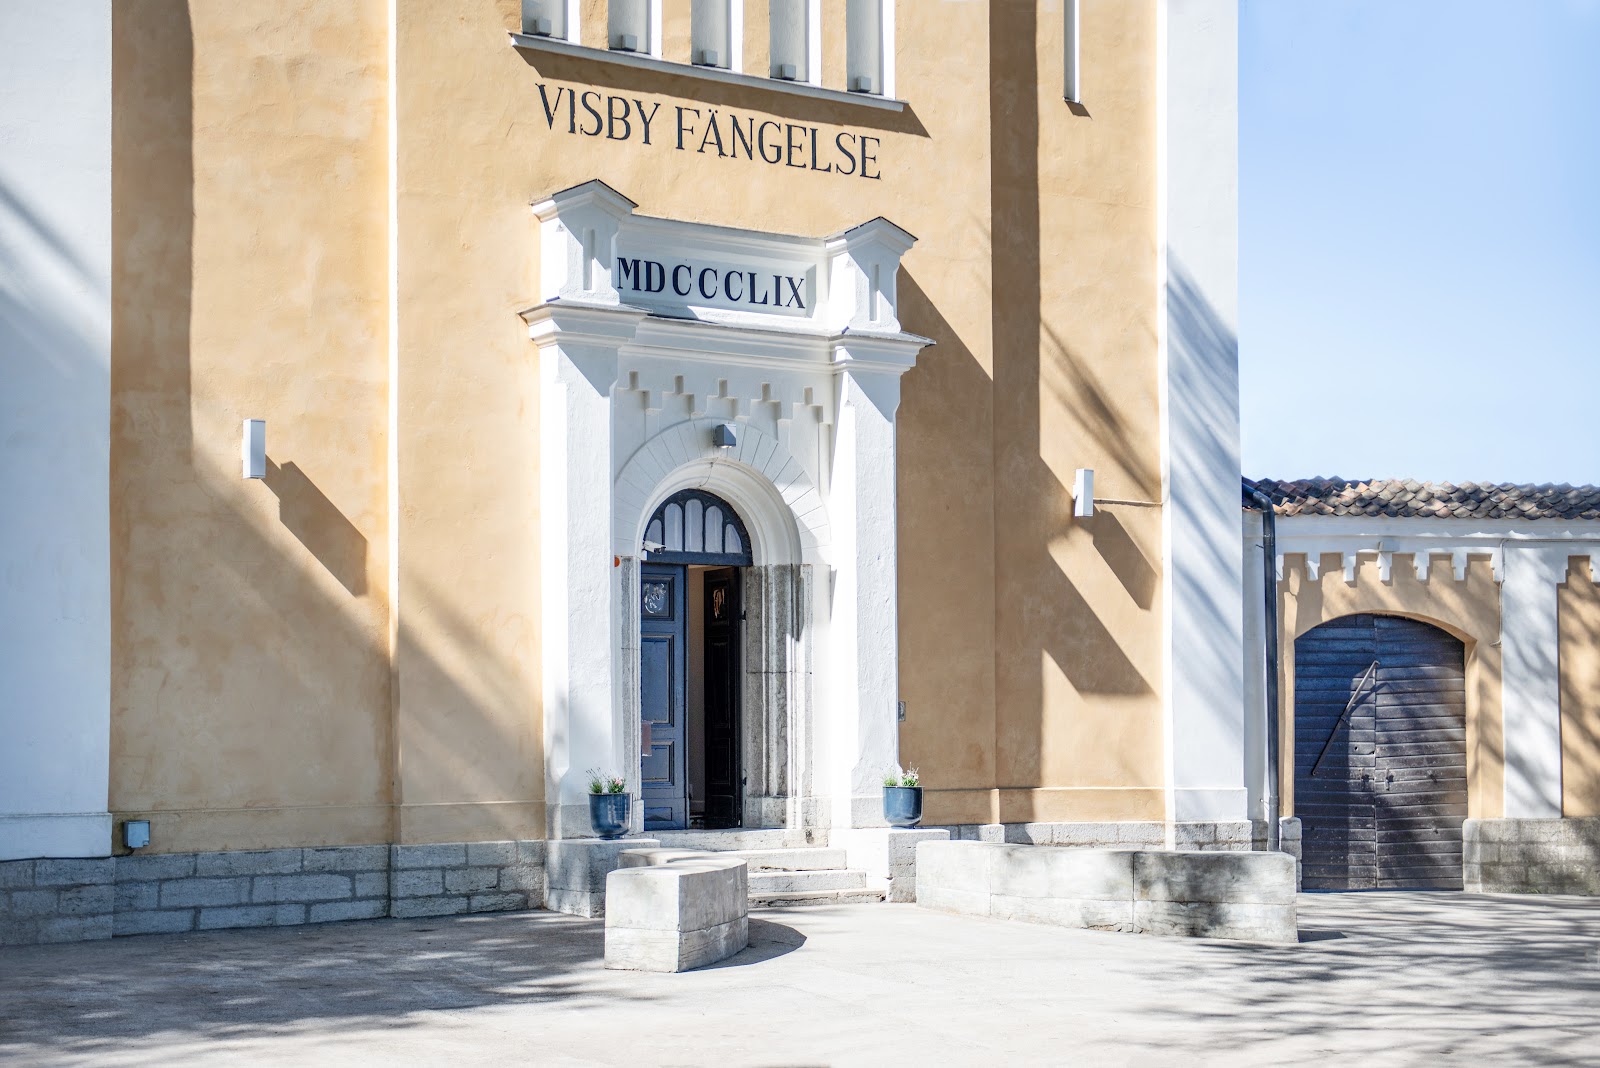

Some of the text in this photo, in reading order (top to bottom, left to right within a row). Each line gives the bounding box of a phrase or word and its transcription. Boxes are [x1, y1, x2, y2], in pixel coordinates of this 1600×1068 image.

[535, 83, 882, 180] VISBY FÄNGELSE
[617, 257, 805, 309] MDCCCLIX
